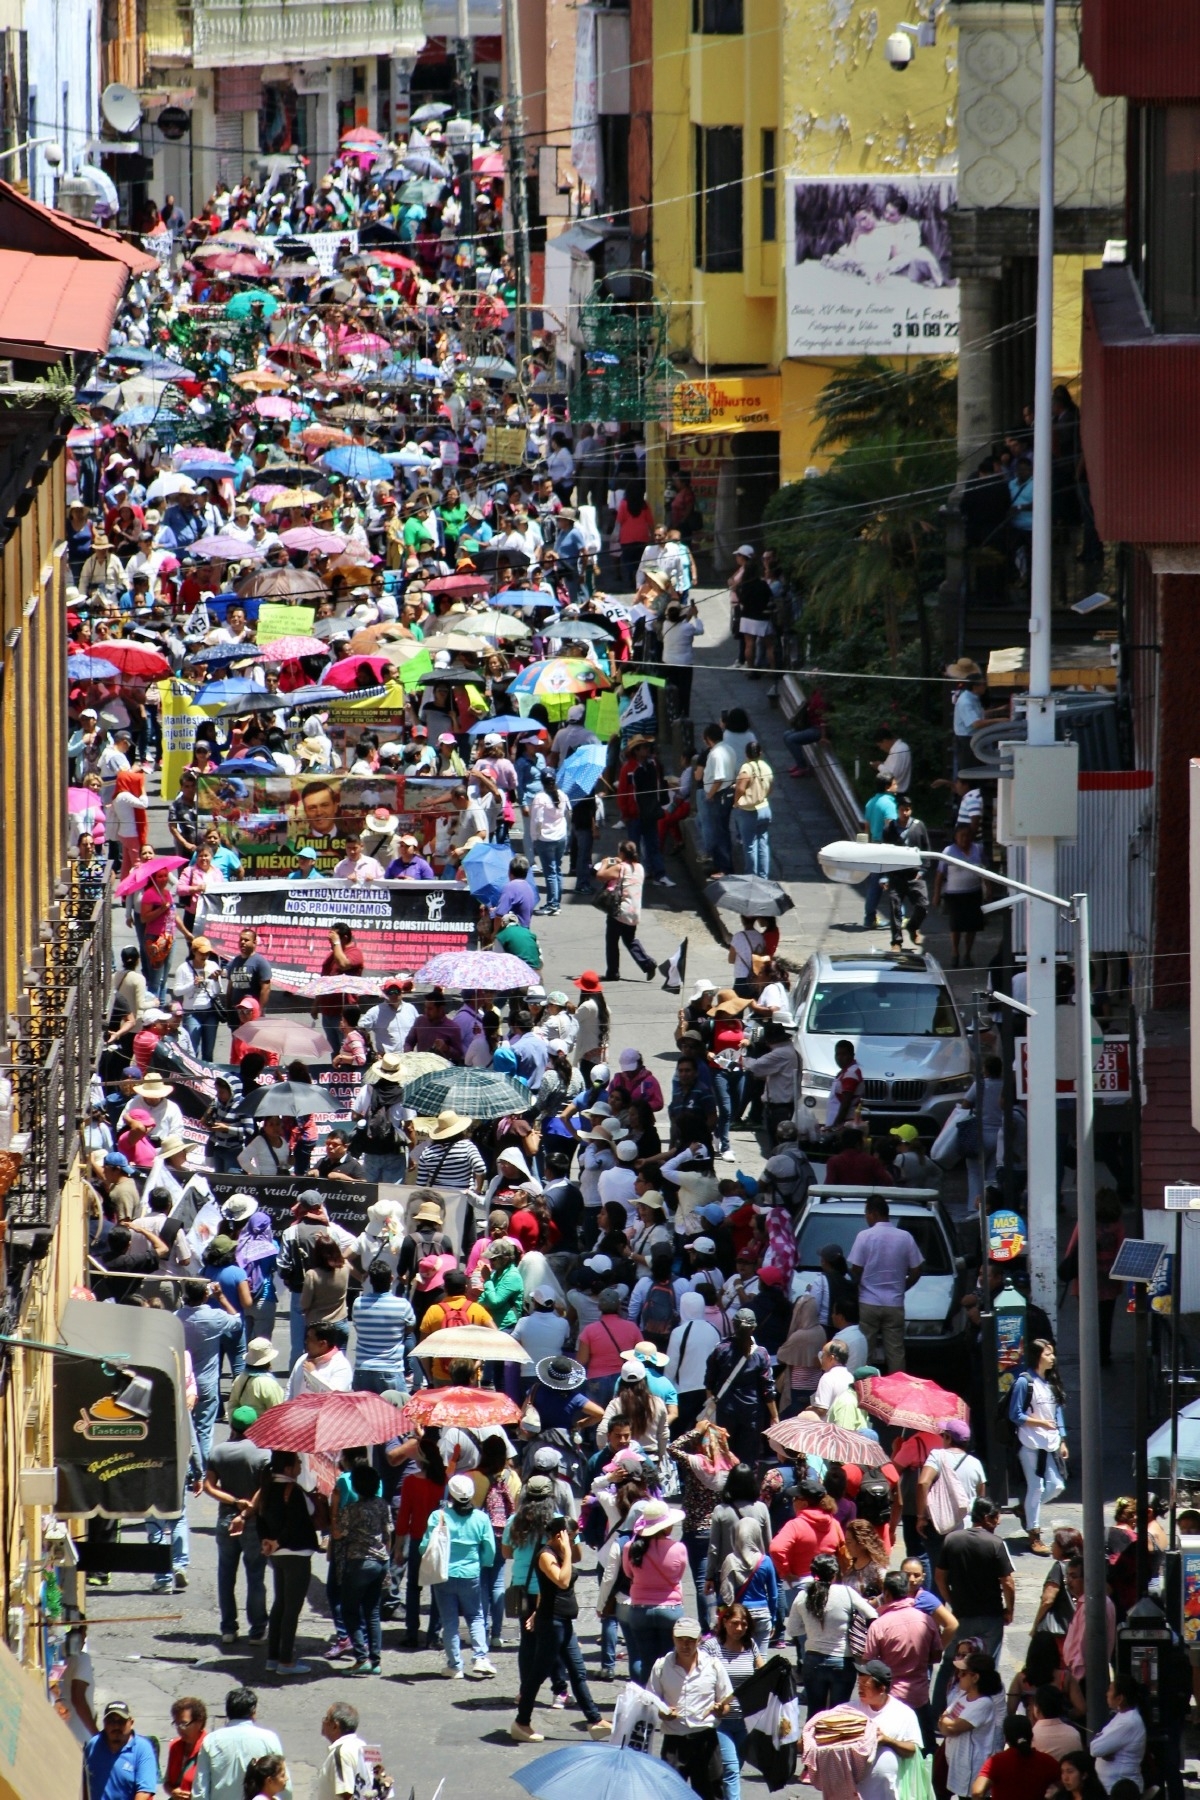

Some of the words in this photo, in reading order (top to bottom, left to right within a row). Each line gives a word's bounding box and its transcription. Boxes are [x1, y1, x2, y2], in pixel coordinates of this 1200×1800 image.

[819, 304, 832, 315] XV
[855, 307, 862, 317] y
[906, 307, 918, 320] La
[849, 325, 854, 333] y
[892, 323, 902, 338] 3
[906, 323, 919, 337] 10
[835, 338, 843, 347] de
[713, 397, 761, 408] MINUTOS
[296, 836, 328, 851] Aquí
[256, 852, 300, 869] MÉXIC
[289, 888, 330, 900] CENTRO,
[331, 888, 389, 900] YECAPIXTLA
[286, 901, 307, 912] NOS
[309, 902, 391, 915] PRONUNCIAMOS:
[206, 913, 240, 922] CONTRA
[241, 915, 252, 924] LA
[252, 914, 290, 925] REFORMA
[291, 917, 298, 925] A
[300, 916, 315, 926] LOS
[375, 920, 382, 930] Y
[382, 920, 393, 930] 73
[393, 920, 475, 932] CONSTITUCIONALES
[383, 931, 394, 941] ES
[408, 932, 469, 944] INSTRUMENTO
[319, 1072, 362, 1084] MOREL
[338, 1087, 352, 1097] LA
[687, 1099, 696, 1109] 2
[213, 1184, 233, 1194] ser
[235, 1185, 259, 1196] ave,
[92, 1425, 141, 1436] Pastecito
[87, 1451, 136, 1473] Recien
